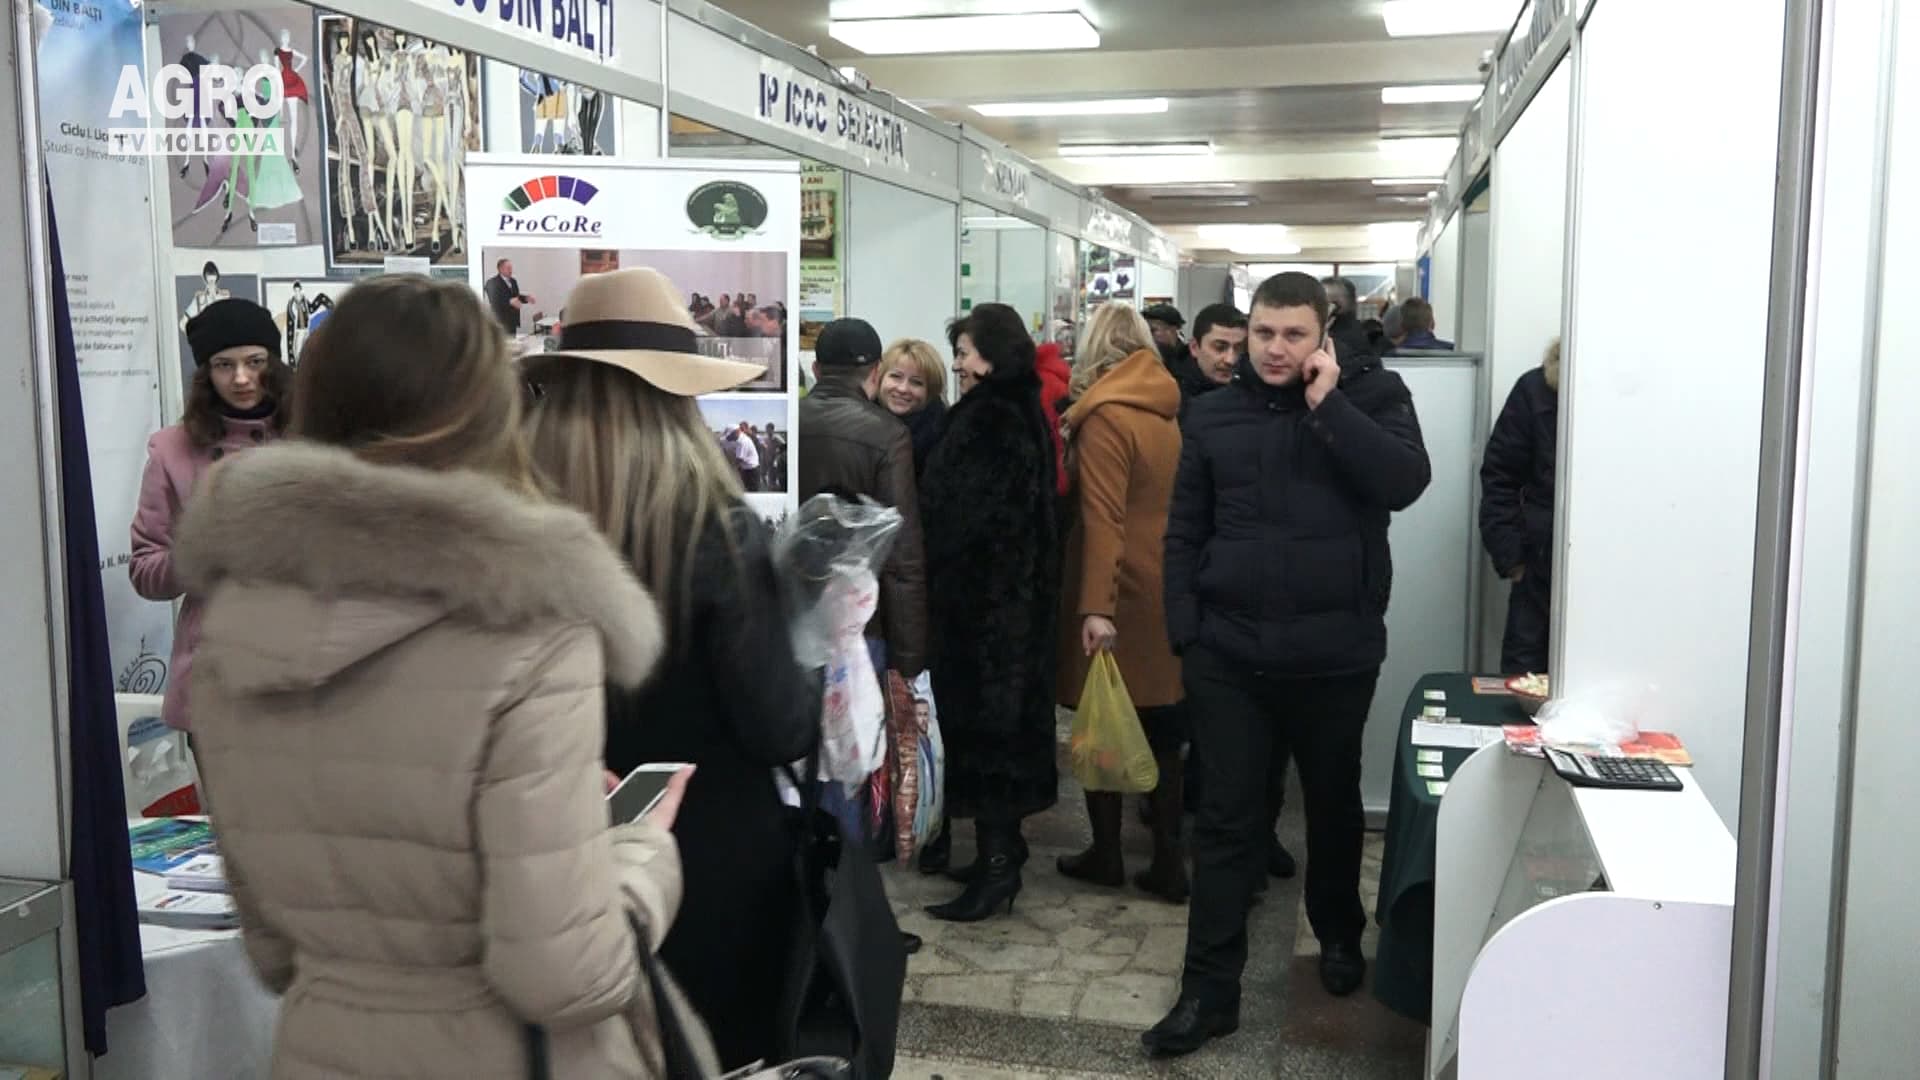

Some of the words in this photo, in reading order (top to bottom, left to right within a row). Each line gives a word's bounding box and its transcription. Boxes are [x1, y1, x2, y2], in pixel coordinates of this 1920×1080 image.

[760, 73, 778, 117] IP
[785, 81, 827, 133] ICCC
[499, 214, 602, 233] ProCoRe
